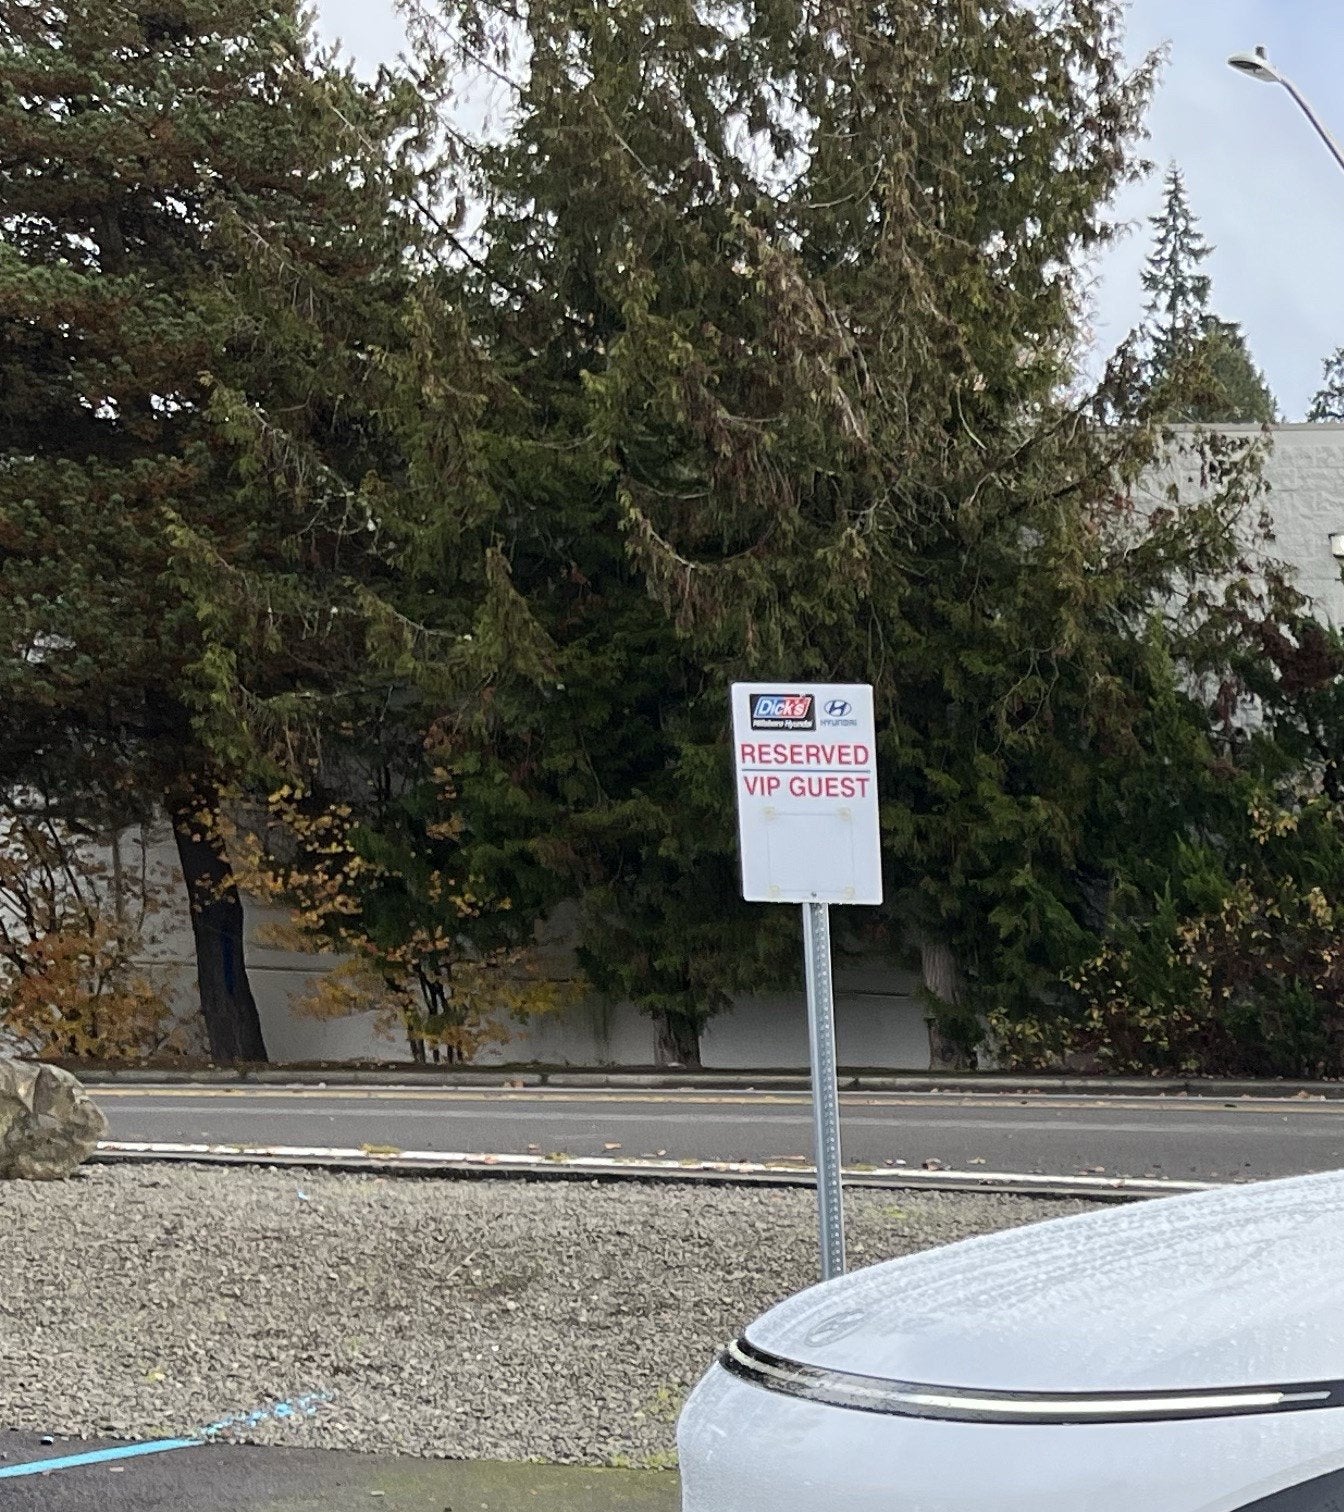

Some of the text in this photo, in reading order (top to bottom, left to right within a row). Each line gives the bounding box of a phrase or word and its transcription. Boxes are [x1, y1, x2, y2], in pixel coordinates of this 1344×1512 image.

[740, 743, 869, 766] RESERVED
[744, 776, 870, 798] VIP GUEST
